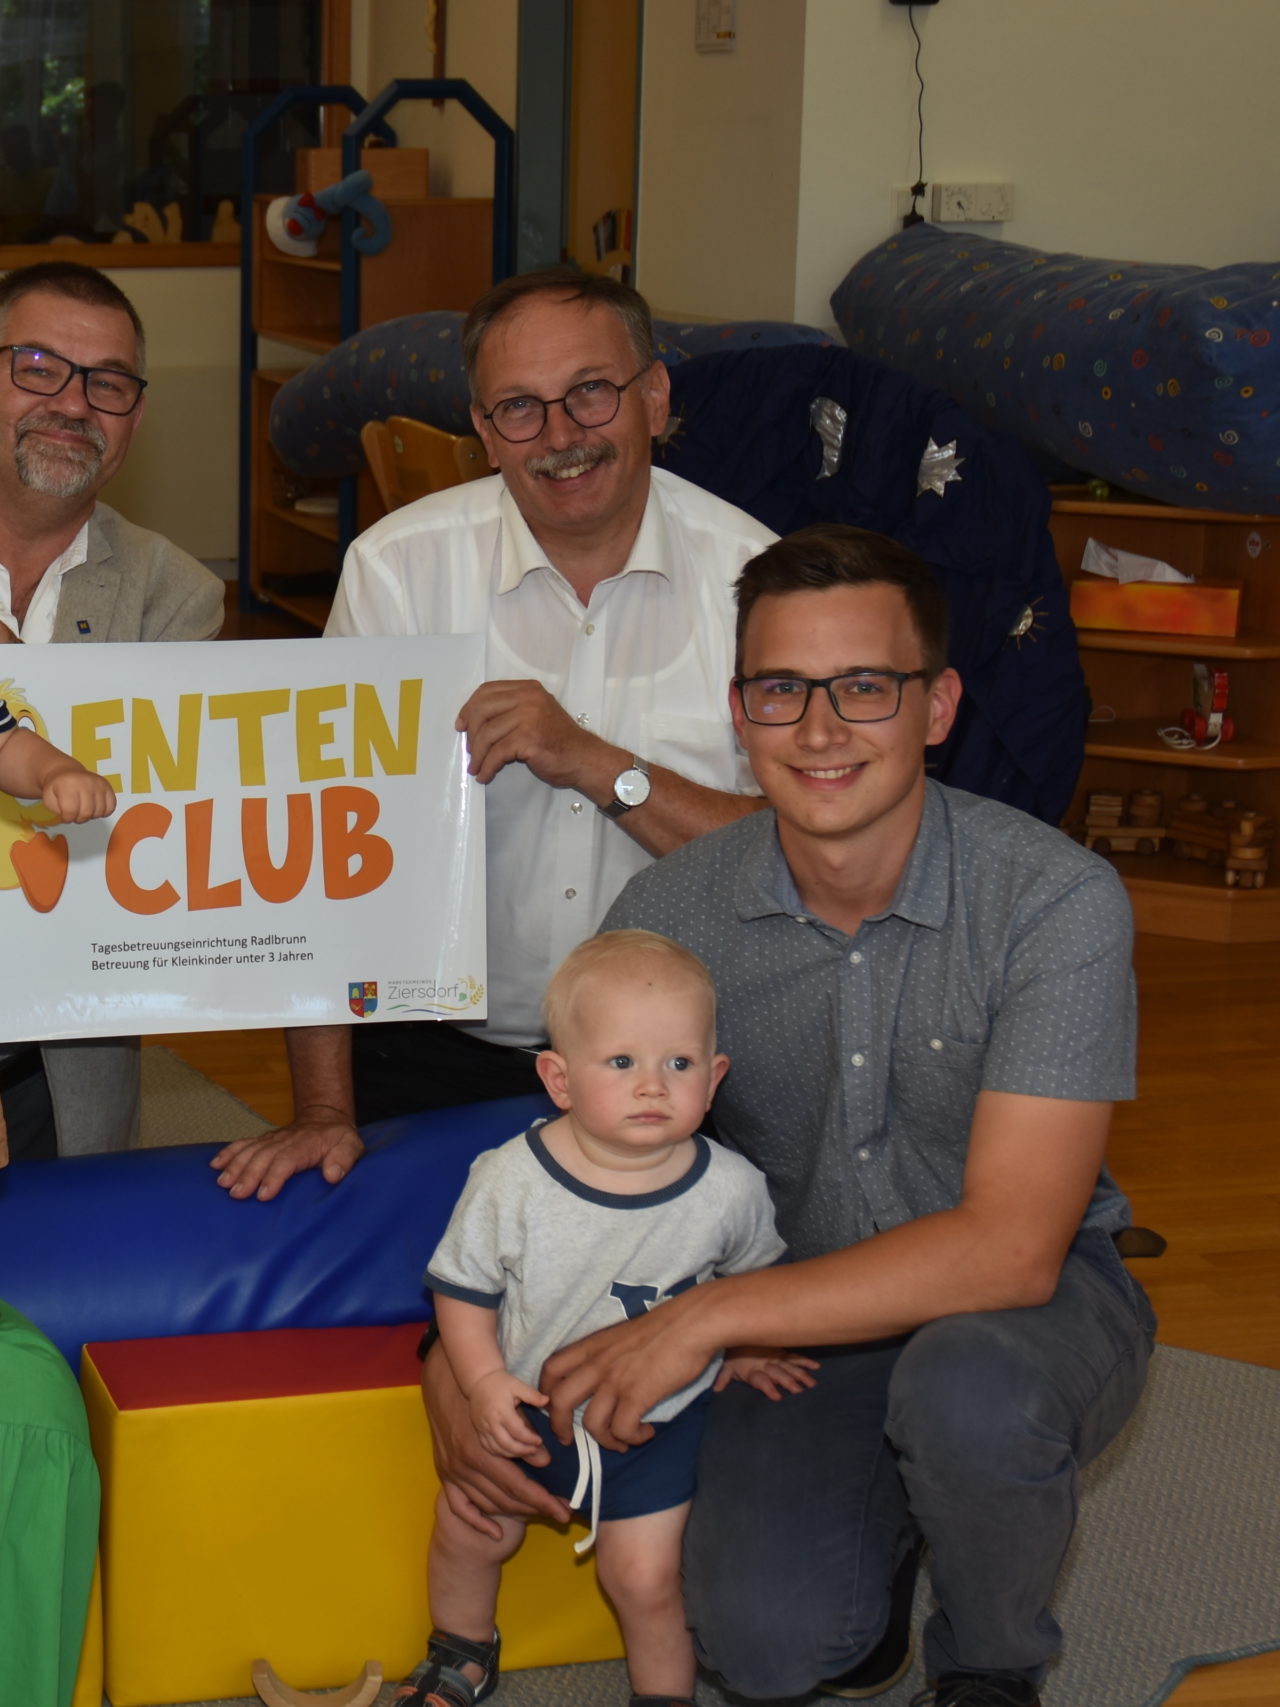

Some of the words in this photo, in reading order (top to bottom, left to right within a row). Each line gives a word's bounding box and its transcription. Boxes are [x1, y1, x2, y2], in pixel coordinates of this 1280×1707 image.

[71, 678, 423, 794] ENTEN
[105, 785, 394, 915] CLUB
[91, 937, 248, 956] Tagesbetreuungseinrichtung
[250, 934, 307, 947] Radlbrunn
[91, 959, 150, 971] Betreuung
[152, 956, 168, 968] für
[171, 953, 233, 967] Kleinkinder
[235, 953, 266, 965] unter
[268, 951, 275, 962] 3
[277, 950, 314, 963] Jahren
[387, 979, 459, 1000] Ziersdorf
